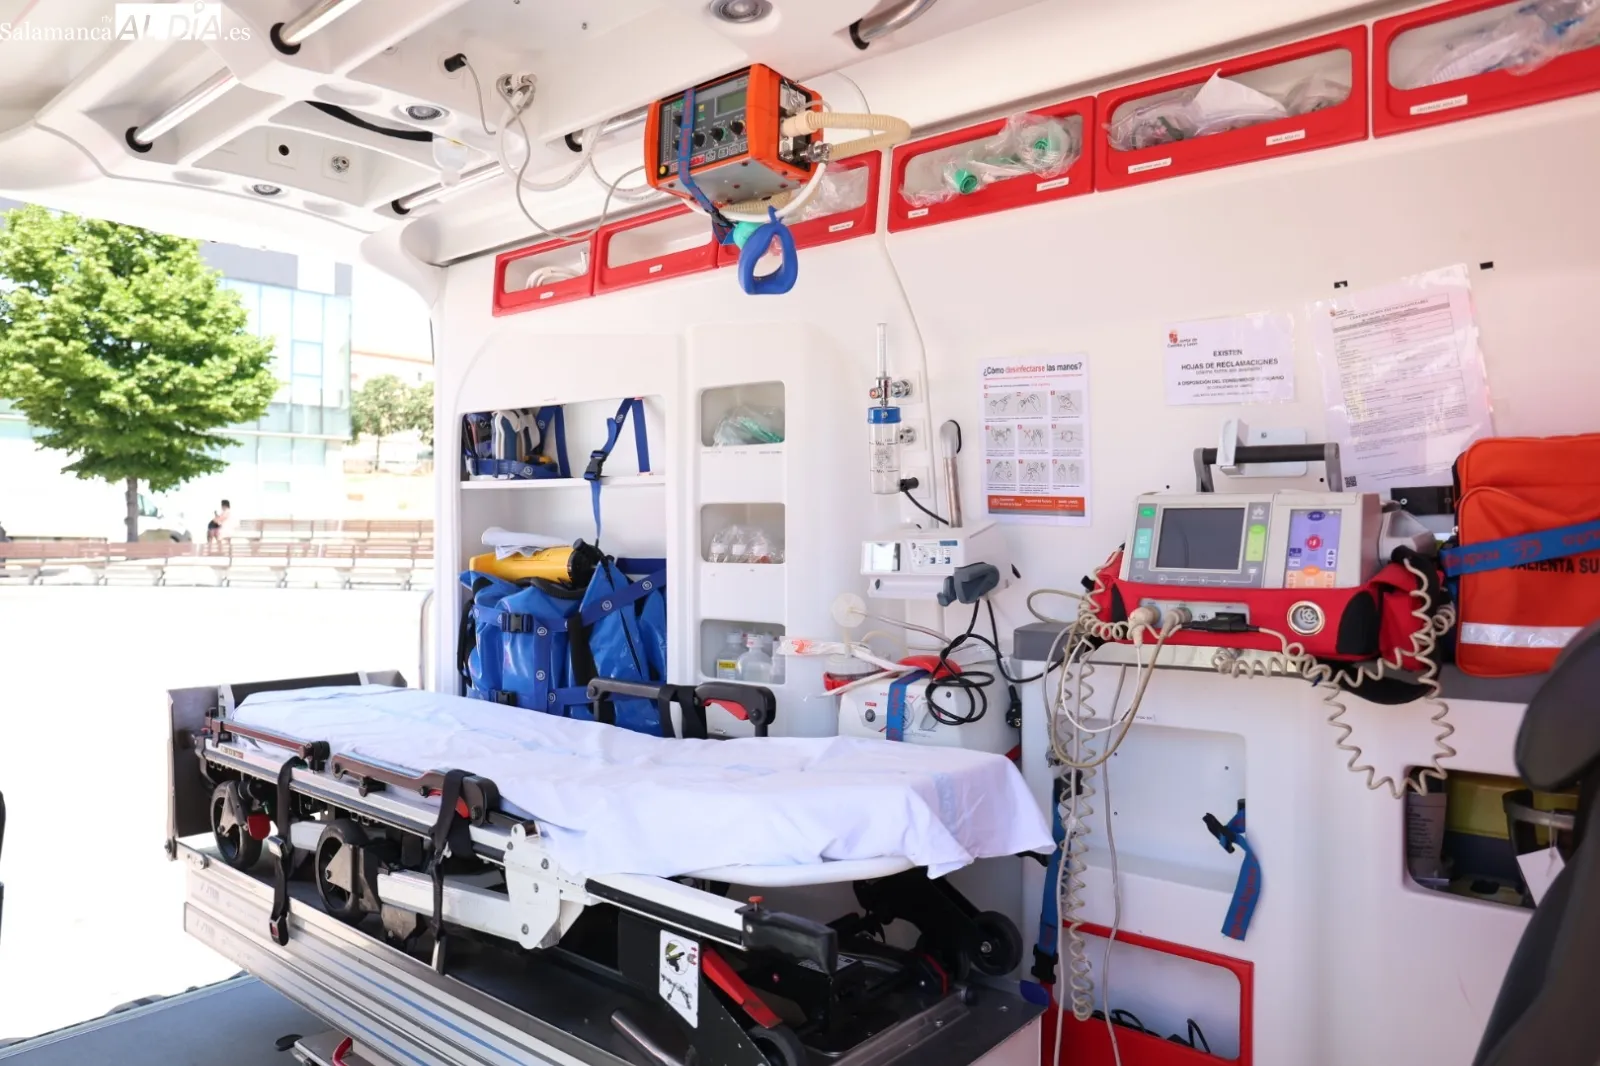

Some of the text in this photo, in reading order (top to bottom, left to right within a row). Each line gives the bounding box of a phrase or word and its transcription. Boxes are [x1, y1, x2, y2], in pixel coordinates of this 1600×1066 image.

[1213, 349, 1243, 357] EXISTEN
[983, 366, 1004, 377] ¿Cómo
[1005, 365, 1046, 374] desinfectarse
[1046, 363, 1055, 371] las
[1056, 362, 1083, 371] manos?
[1181, 362, 1204, 370] HOJAS
[1216, 358, 1279, 368] RECLAMACIONES
[1509, 557, 1574, 573] ALIENTA
